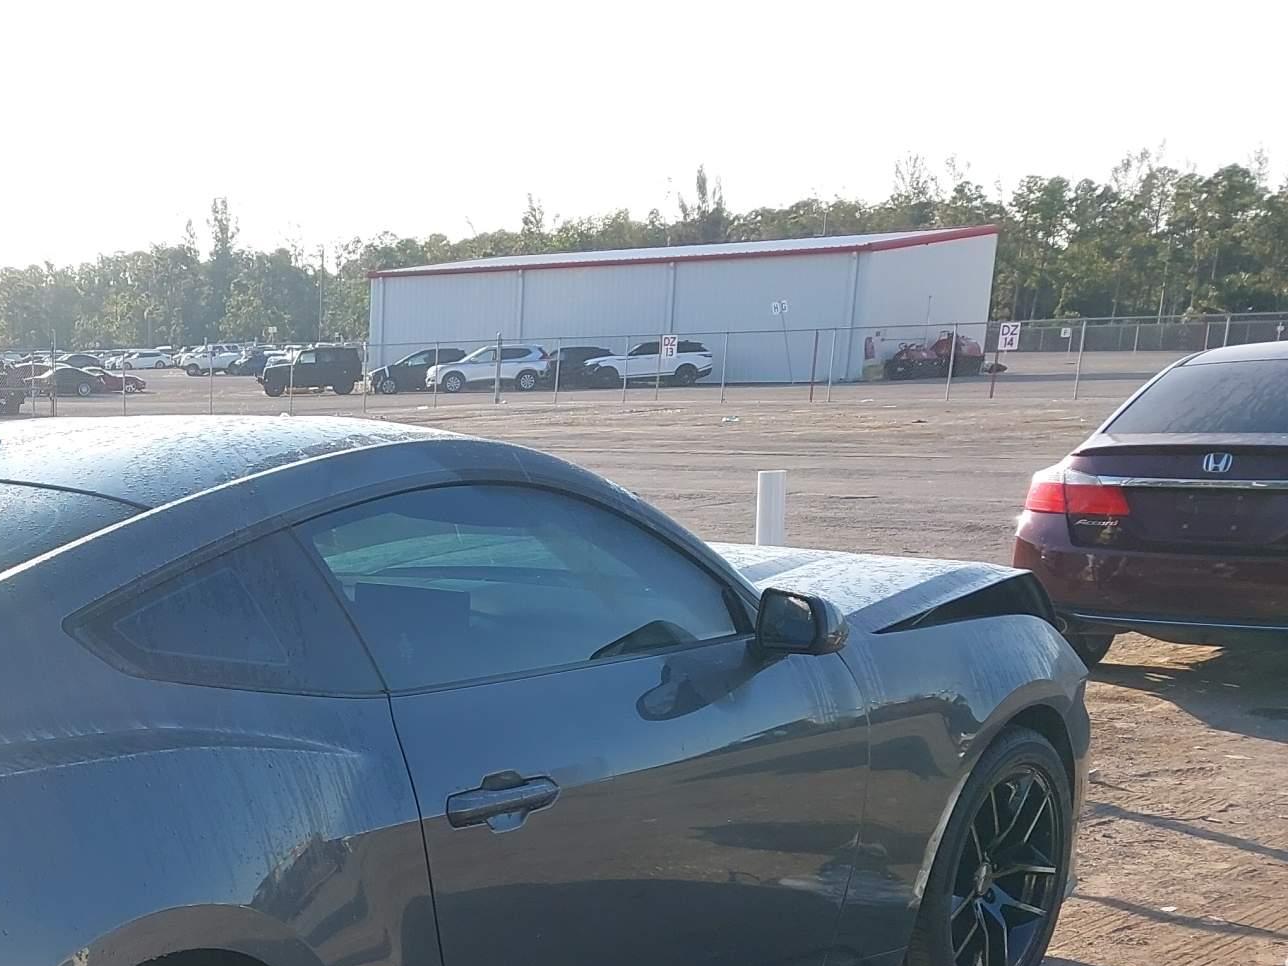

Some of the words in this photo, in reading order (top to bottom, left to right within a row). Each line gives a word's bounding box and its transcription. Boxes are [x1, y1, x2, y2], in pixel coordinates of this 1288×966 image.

[1001, 324, 1020, 336] DZ
[663, 336, 677, 347] DZ
[1003, 336, 1014, 348] 14
[664, 347, 674, 357] 13
